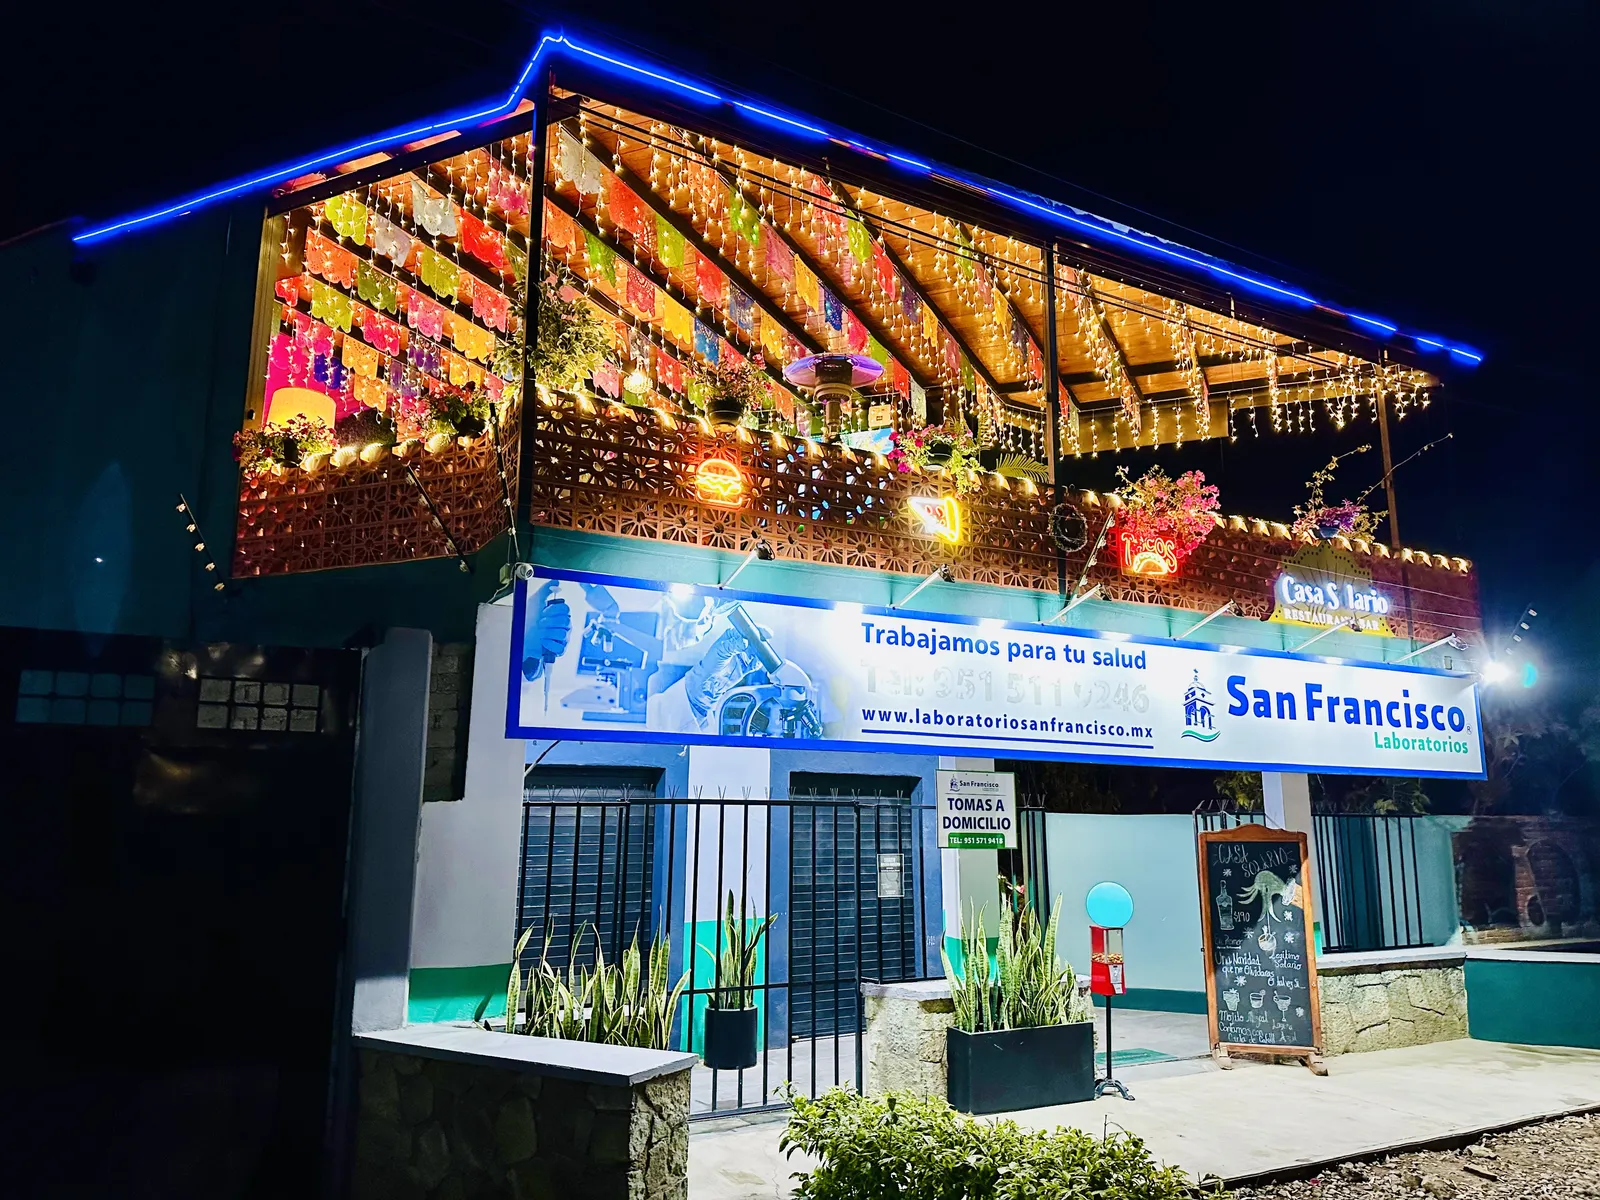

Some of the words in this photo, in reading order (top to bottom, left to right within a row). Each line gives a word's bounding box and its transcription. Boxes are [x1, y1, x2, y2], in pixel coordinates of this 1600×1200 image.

[1281, 575, 1324, 605] Casa
[1326, 582, 1388, 614] Slario
[861, 622, 1000, 656] Trabajamos
[1008, 641, 1056, 662] para
[1063, 644, 1085, 663] tu
[1093, 648, 1147, 669] salud
[1227, 675, 1297, 721] San
[1305, 683, 1465, 733] Francisco
[861, 706, 1154, 738] www.laboratoriosanfrancisco.mx
[1374, 732, 1469, 754] Laboratorios
[947, 798, 993, 812] TOMAS
[995, 799, 1005, 812] A
[943, 816, 1011, 830] DOMICILIO
[1218, 844, 1249, 864] CASA
